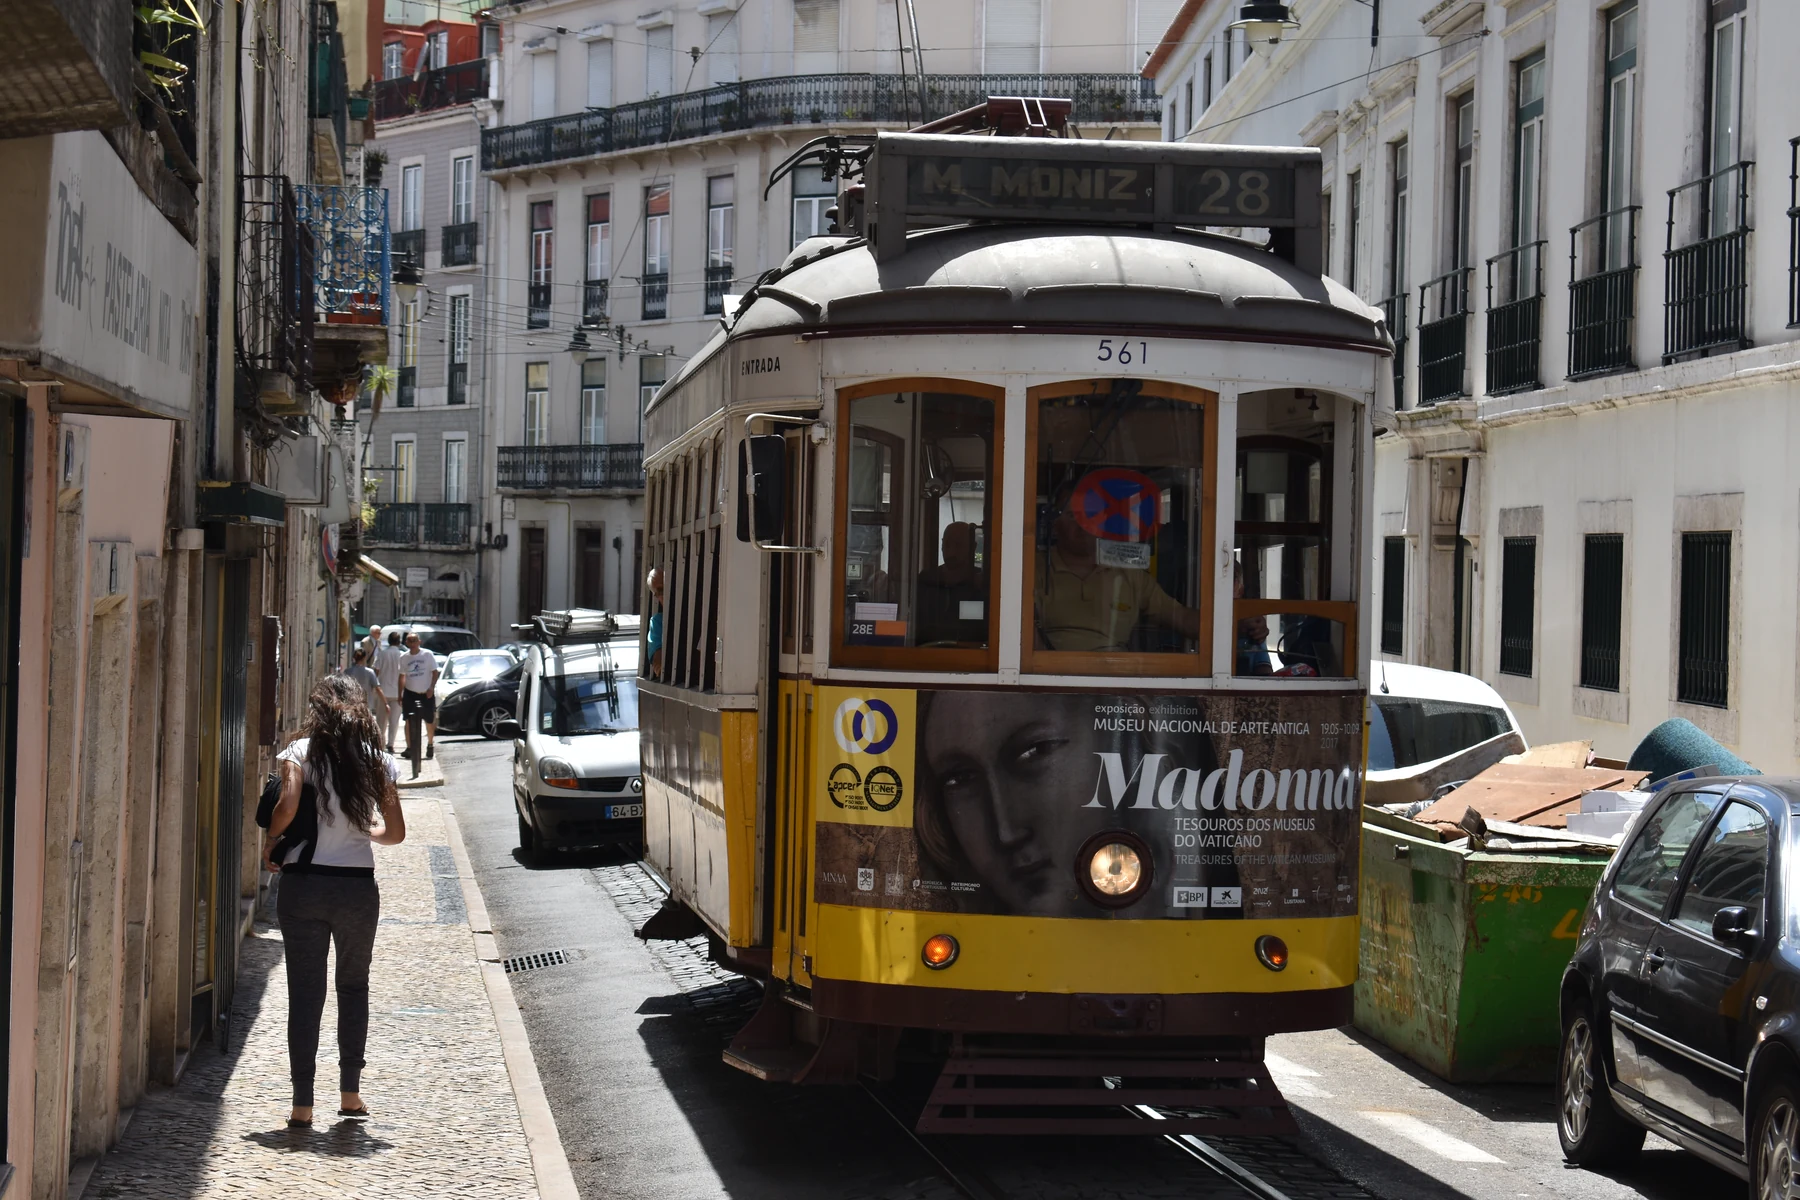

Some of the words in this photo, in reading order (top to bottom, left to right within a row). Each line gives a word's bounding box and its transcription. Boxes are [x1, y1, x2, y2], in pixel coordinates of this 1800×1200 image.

[991, 166, 1137, 200] MONIZ
[1199, 169, 1270, 215] 28
[102, 241, 151, 356] PASTELARIA
[1097, 339, 1147, 365] 561
[741, 356, 781, 376] ENTRADA
[852, 623, 873, 635] 28E
[1094, 703, 1145, 715] exposição
[1148, 704, 1198, 716] exhibition
[1093, 718, 1145, 733] MUSEU
[1148, 719, 1218, 734] NACIONAL
[1221, 721, 1238, 734] DE
[1239, 721, 1269, 735] ARTE
[1271, 722, 1310, 735] ANTIGA
[1320, 737, 1338, 749] 2017
[1081, 748, 1355, 811] Madonna
[871, 784, 894, 794] IQNet
[1174, 817, 1243, 831] TESOUROS
[1247, 818, 1270, 831] DOS
[1273, 818, 1315, 831] MUSEUS
[1174, 834, 1195, 848] DO
[1197, 834, 1262, 848] VATICANO
[1175, 854, 1232, 865] TREASURES
[1234, 854, 1246, 865] OF
[1249, 854, 1265, 865] THE
[1267, 854, 1301, 865] VATICAN
[1302, 853, 1336, 864] MUSEUMS
[822, 872, 847, 884] MNAA
[1189, 892, 1204, 902] BPI
